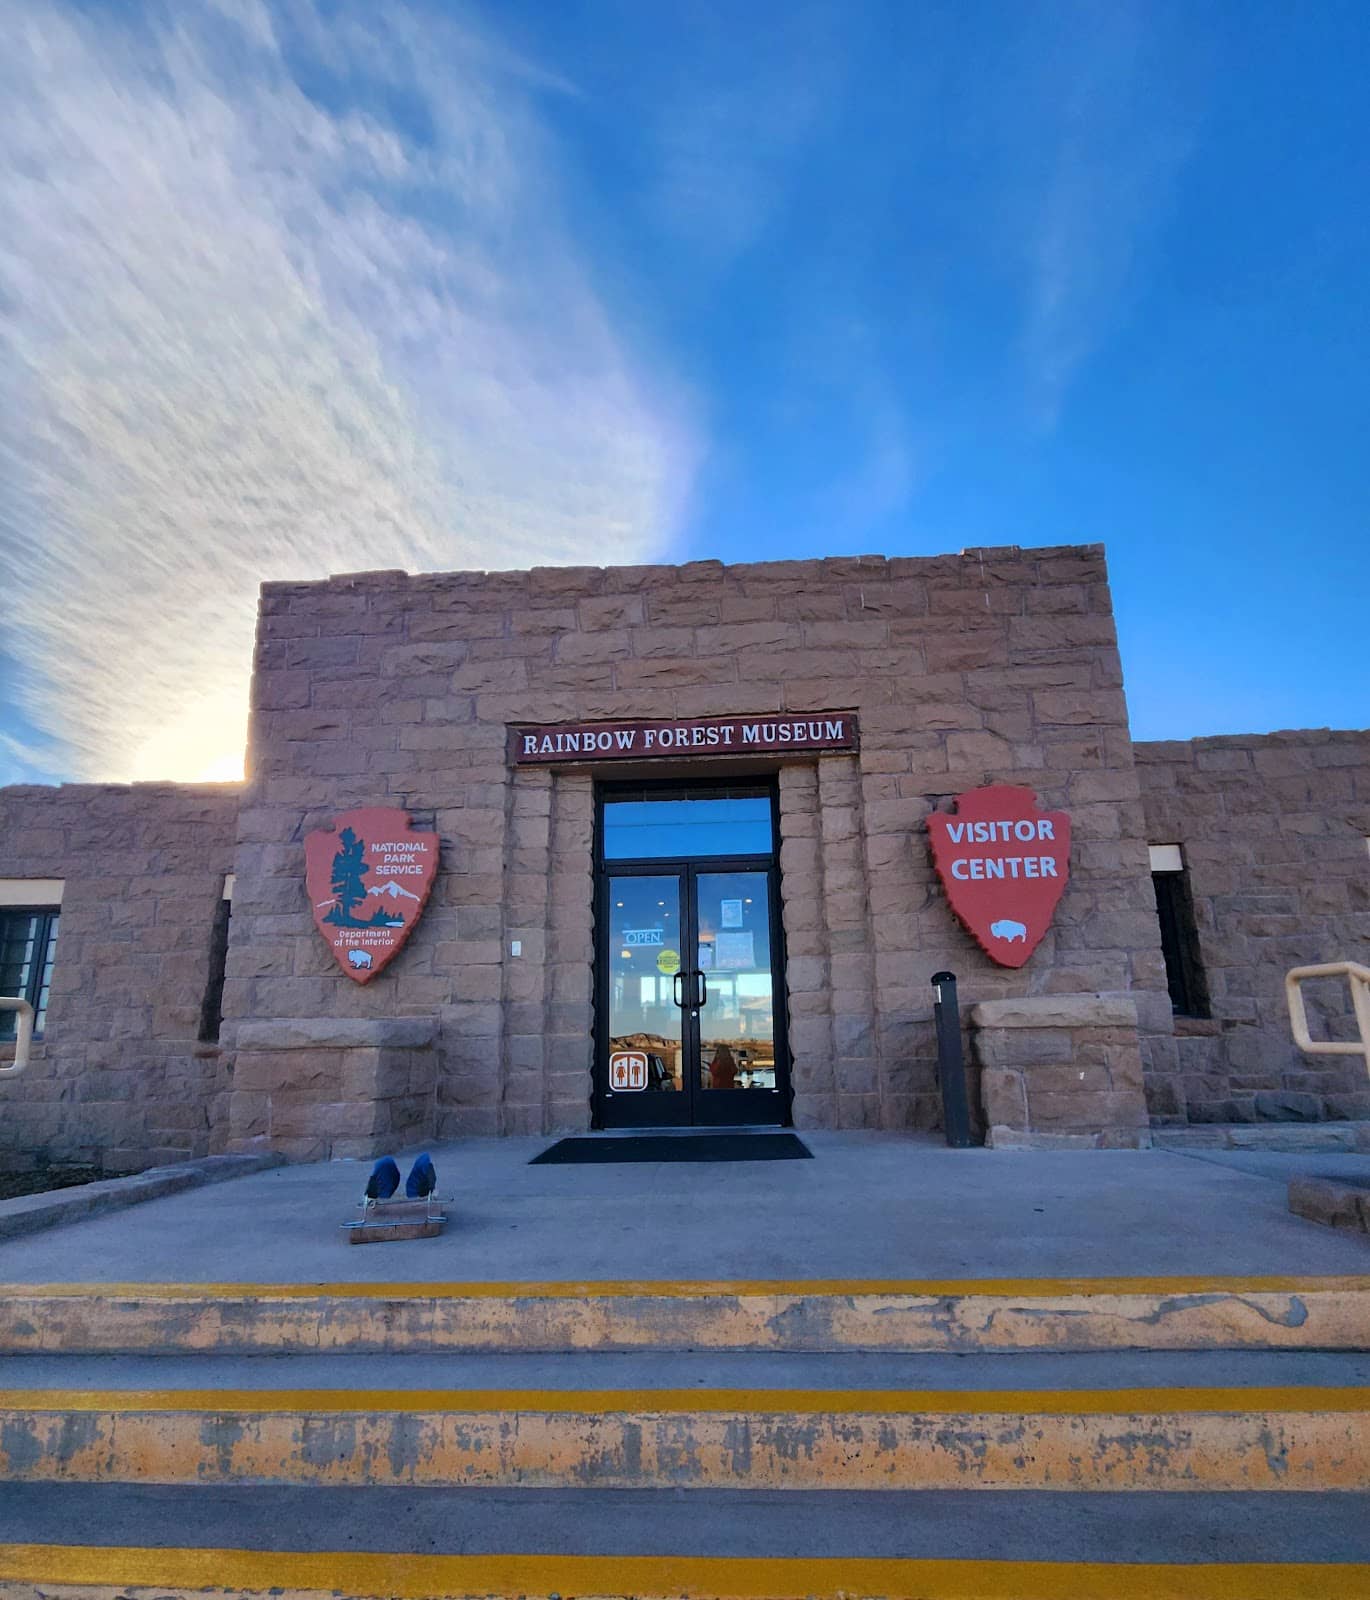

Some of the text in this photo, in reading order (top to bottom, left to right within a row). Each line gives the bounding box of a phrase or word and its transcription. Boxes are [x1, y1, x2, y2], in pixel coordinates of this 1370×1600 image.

[523, 720, 844, 754] RAINBOW FOREST MUSEUM
[946, 819, 1055, 843] VISITOR
[371, 843, 428, 852] NATIONAL
[384, 854, 415, 863] PARK
[375, 865, 423, 875] SERVICE
[951, 856, 1058, 880] CENTER
[339, 930, 391, 938] Department
[626, 932, 660, 944] OPEN
[334, 937, 395, 946] of the Interior
